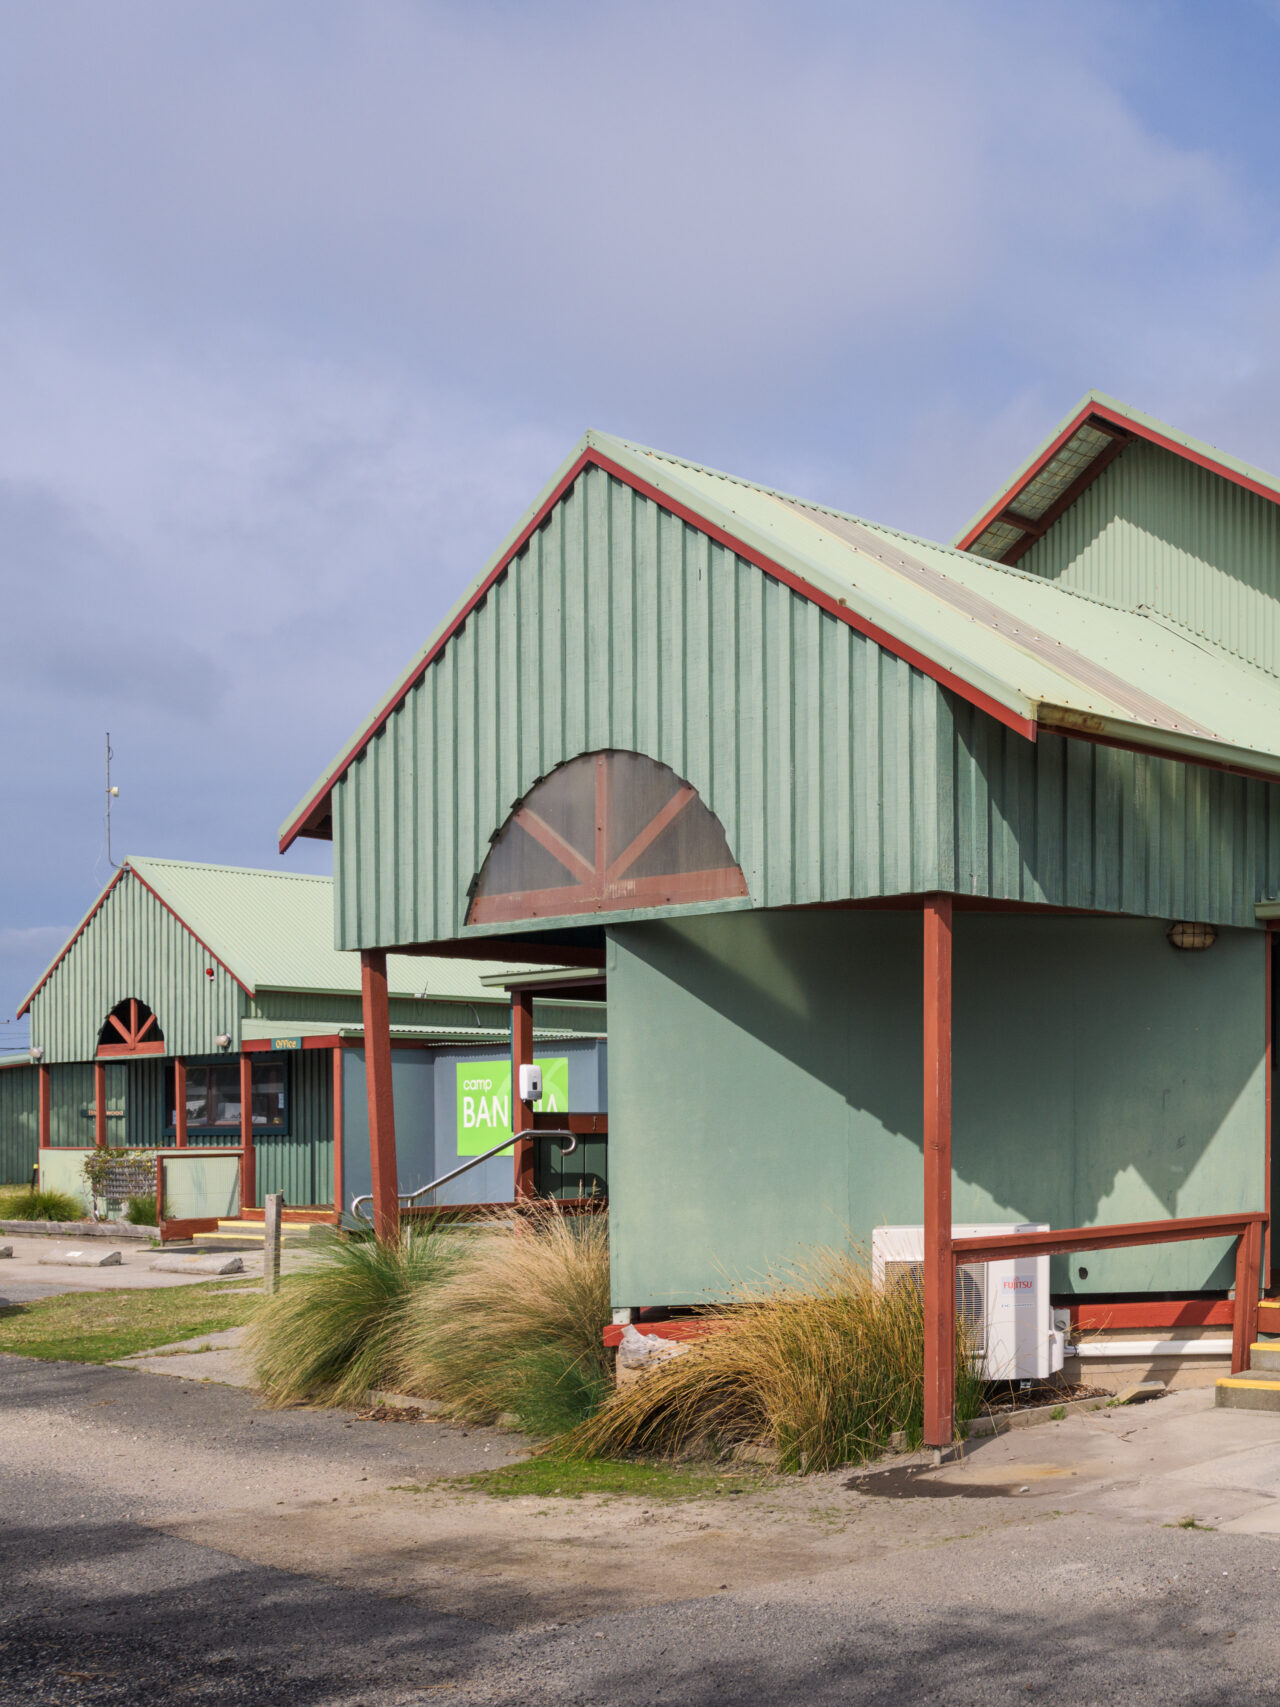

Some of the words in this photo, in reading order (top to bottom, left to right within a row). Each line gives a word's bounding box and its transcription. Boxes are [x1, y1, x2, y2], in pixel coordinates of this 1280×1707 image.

[275, 1039, 297, 1049] Office
[463, 1079, 492, 1093] camp
[1003, 1276, 1033, 1291] FUJITSU
